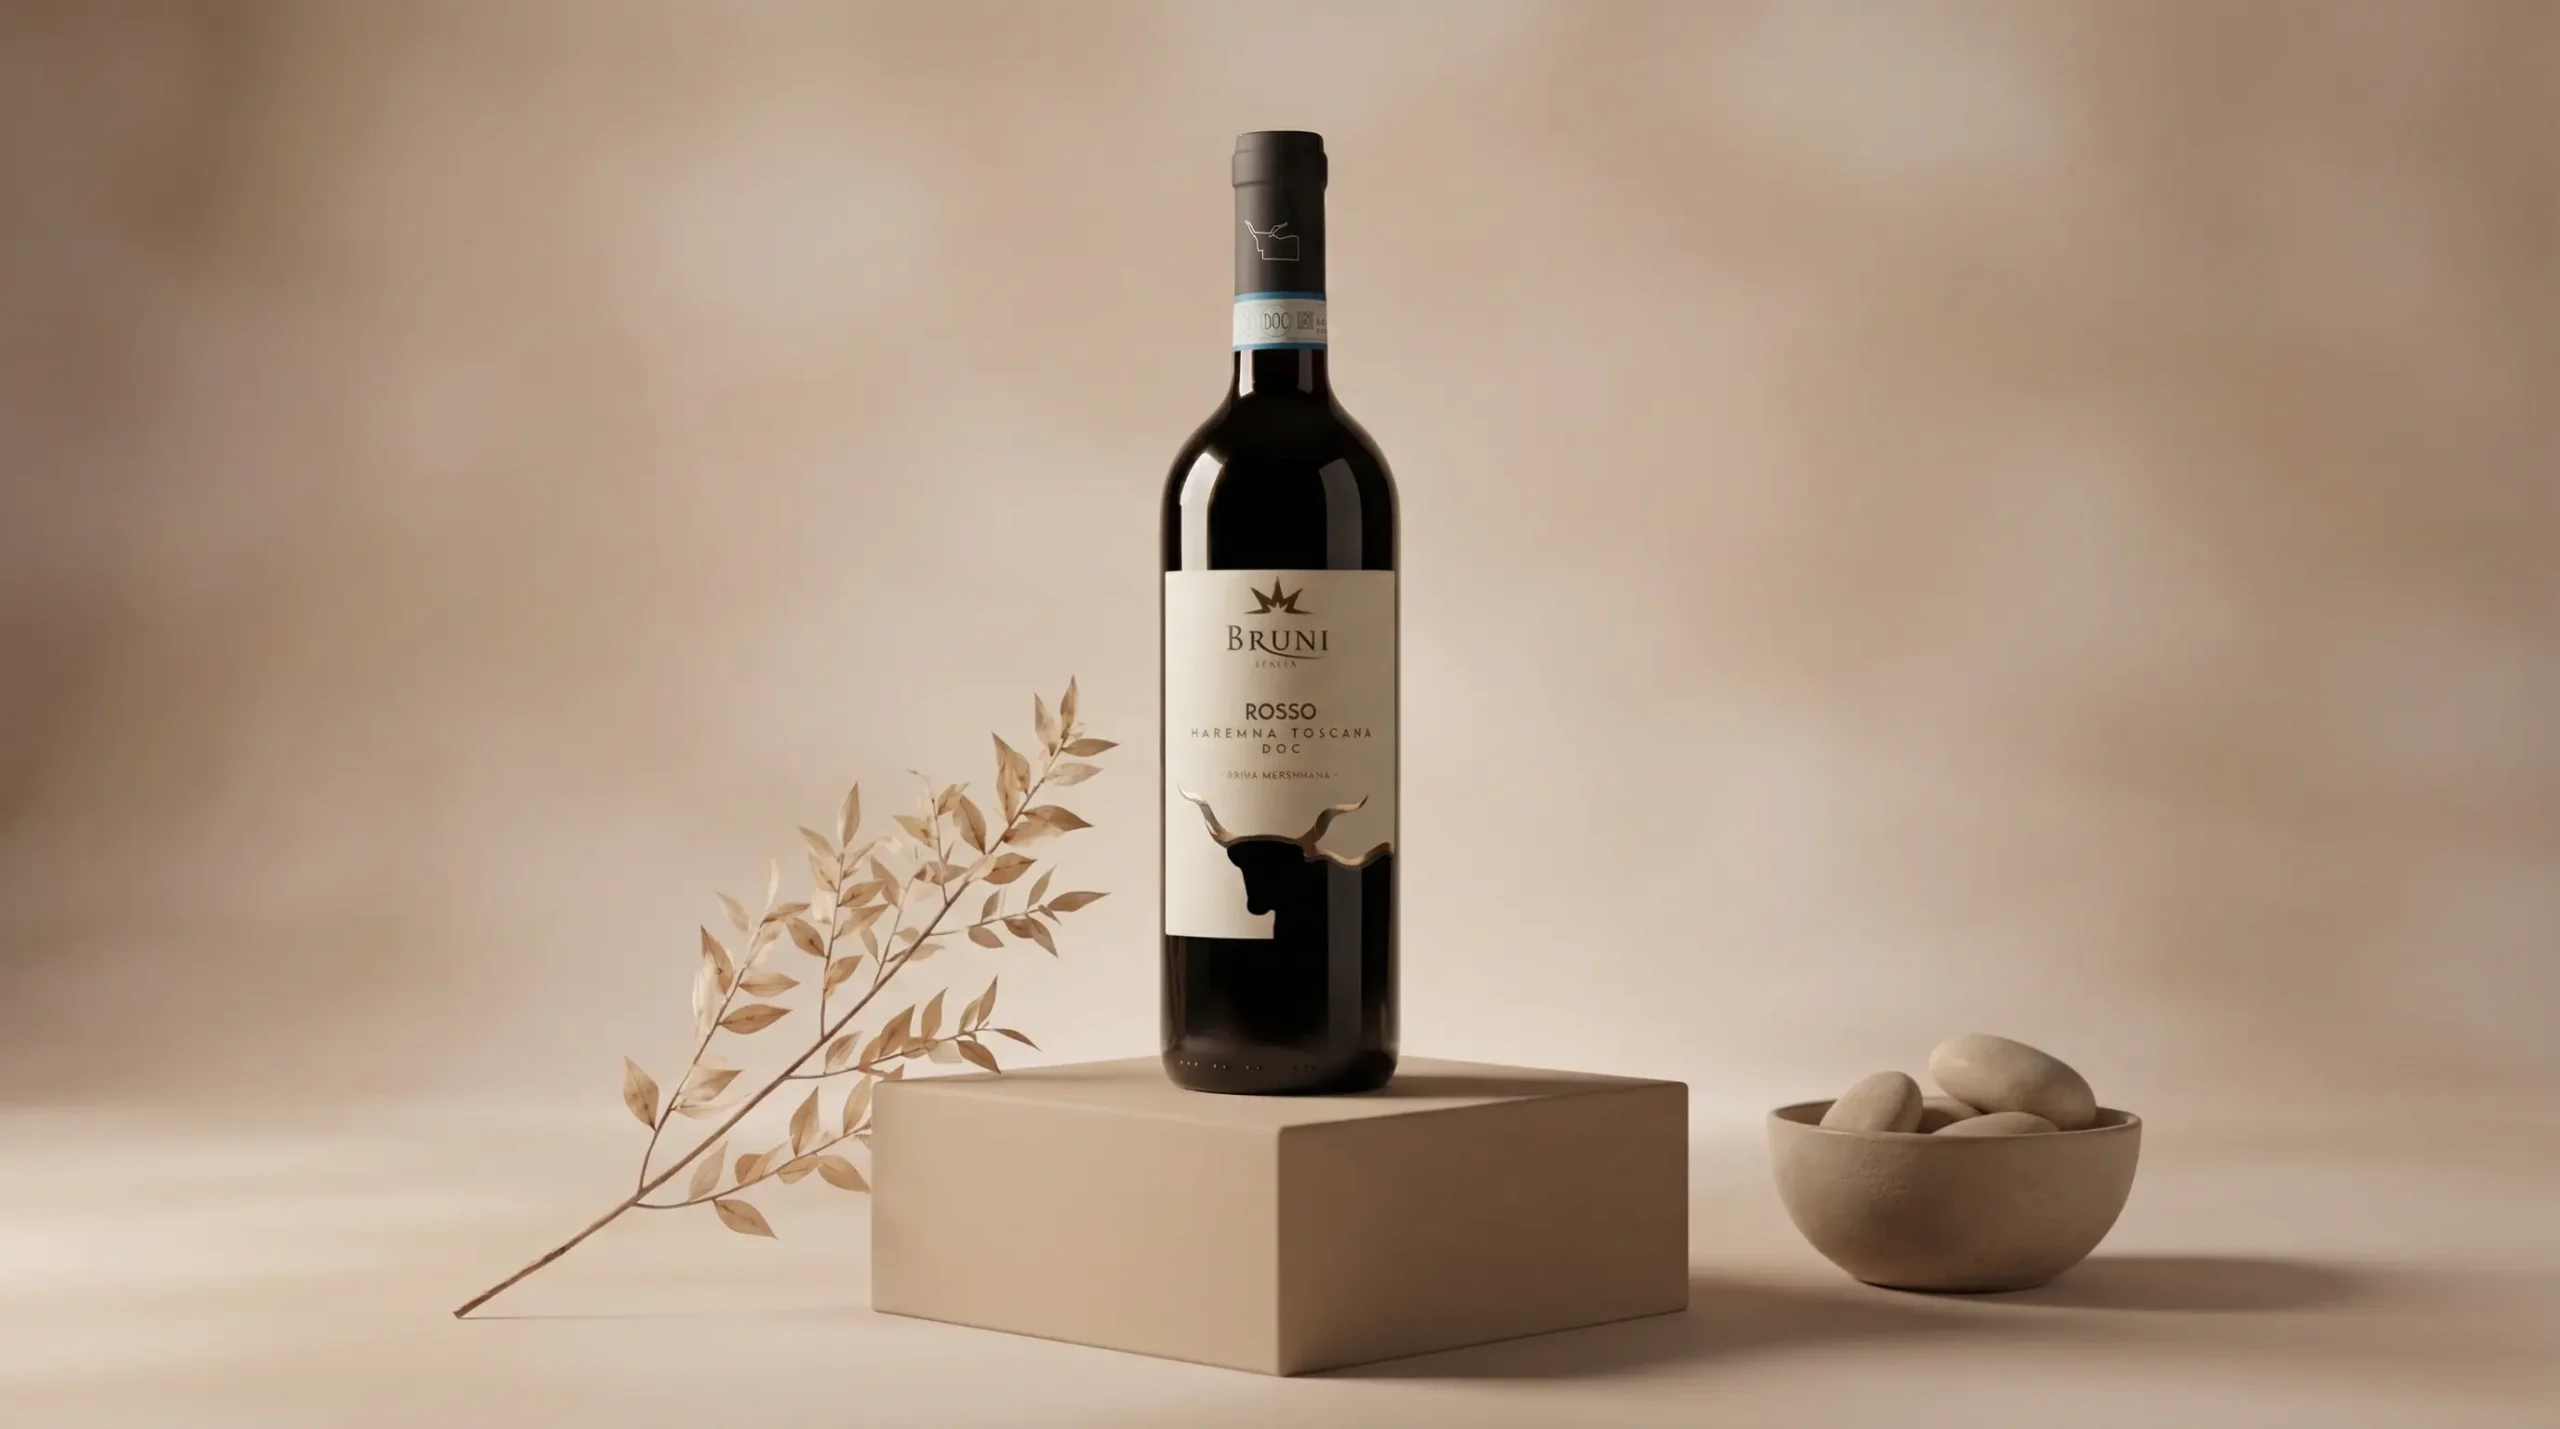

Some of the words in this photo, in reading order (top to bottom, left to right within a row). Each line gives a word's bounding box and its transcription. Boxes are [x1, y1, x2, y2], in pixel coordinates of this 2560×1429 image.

[1263, 312, 1290, 330] DOC
[1226, 624, 1329, 660] BRUNI
[1245, 702, 1317, 721] ROSSO
[1291, 727, 1372, 739] TOSCANA
[1261, 743, 1301, 754] DOC
